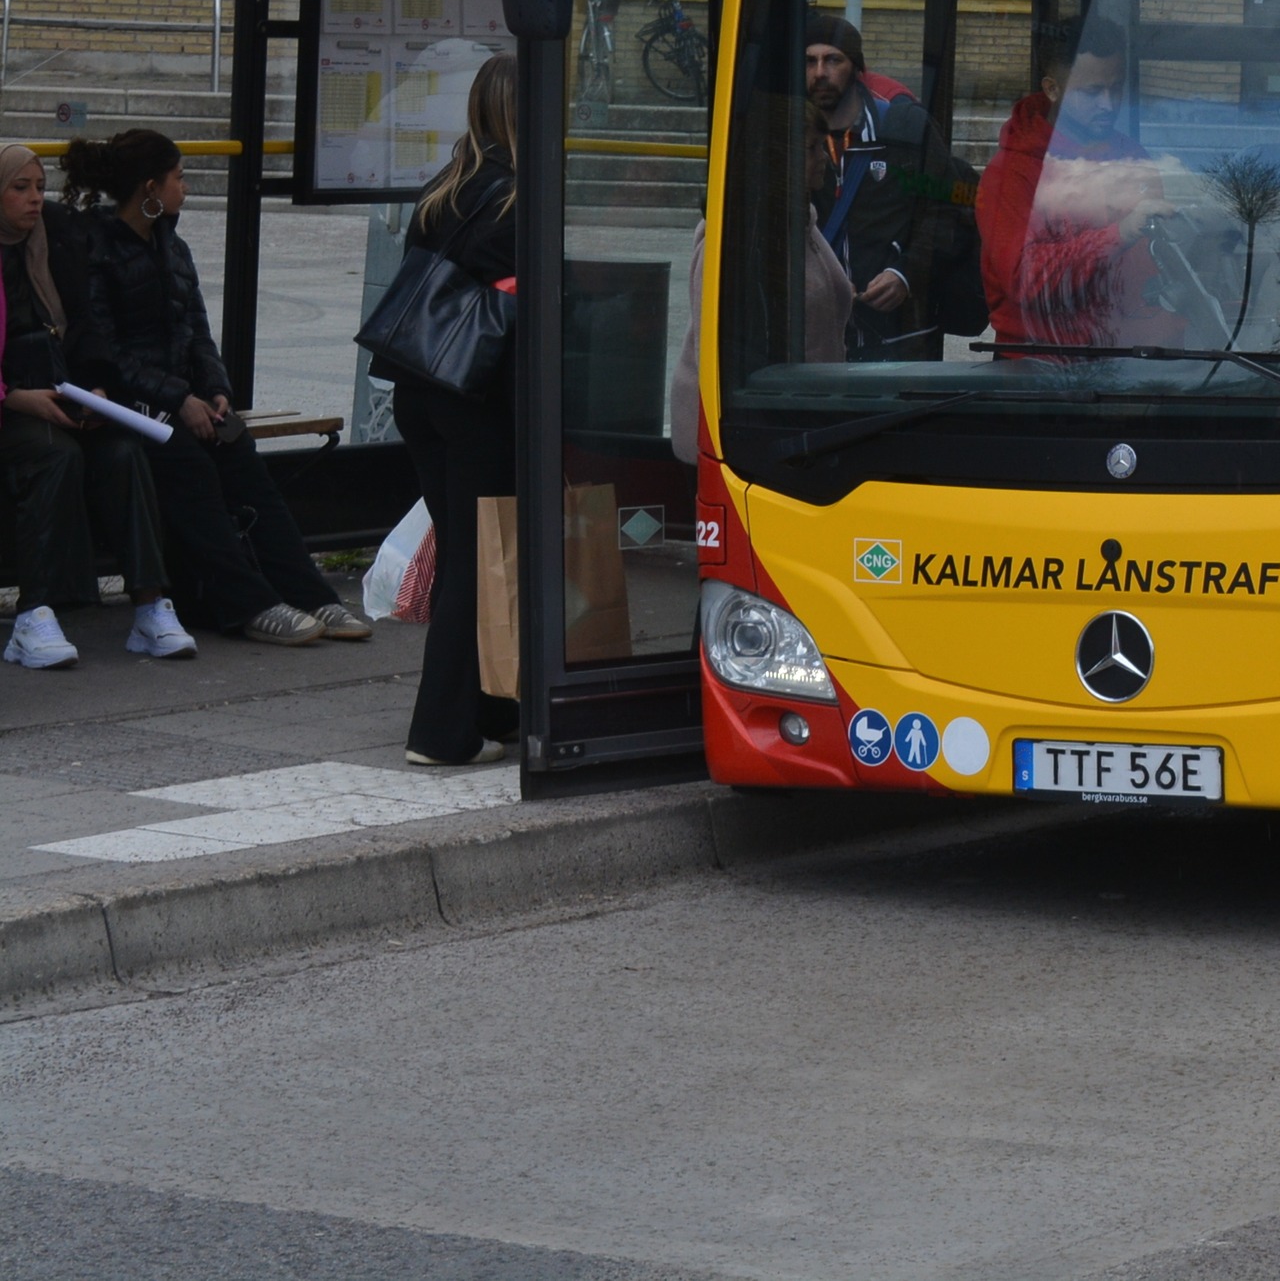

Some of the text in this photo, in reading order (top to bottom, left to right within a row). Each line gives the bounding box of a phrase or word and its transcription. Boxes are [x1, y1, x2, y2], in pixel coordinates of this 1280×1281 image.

[863, 553, 892, 568] CNG
[912, 553, 1064, 590] KALMAR
[1021, 770, 1029, 781] S
[1046, 747, 1202, 791] TTF 56E
[1082, 792, 1148, 804] bergkvarabuss.se
